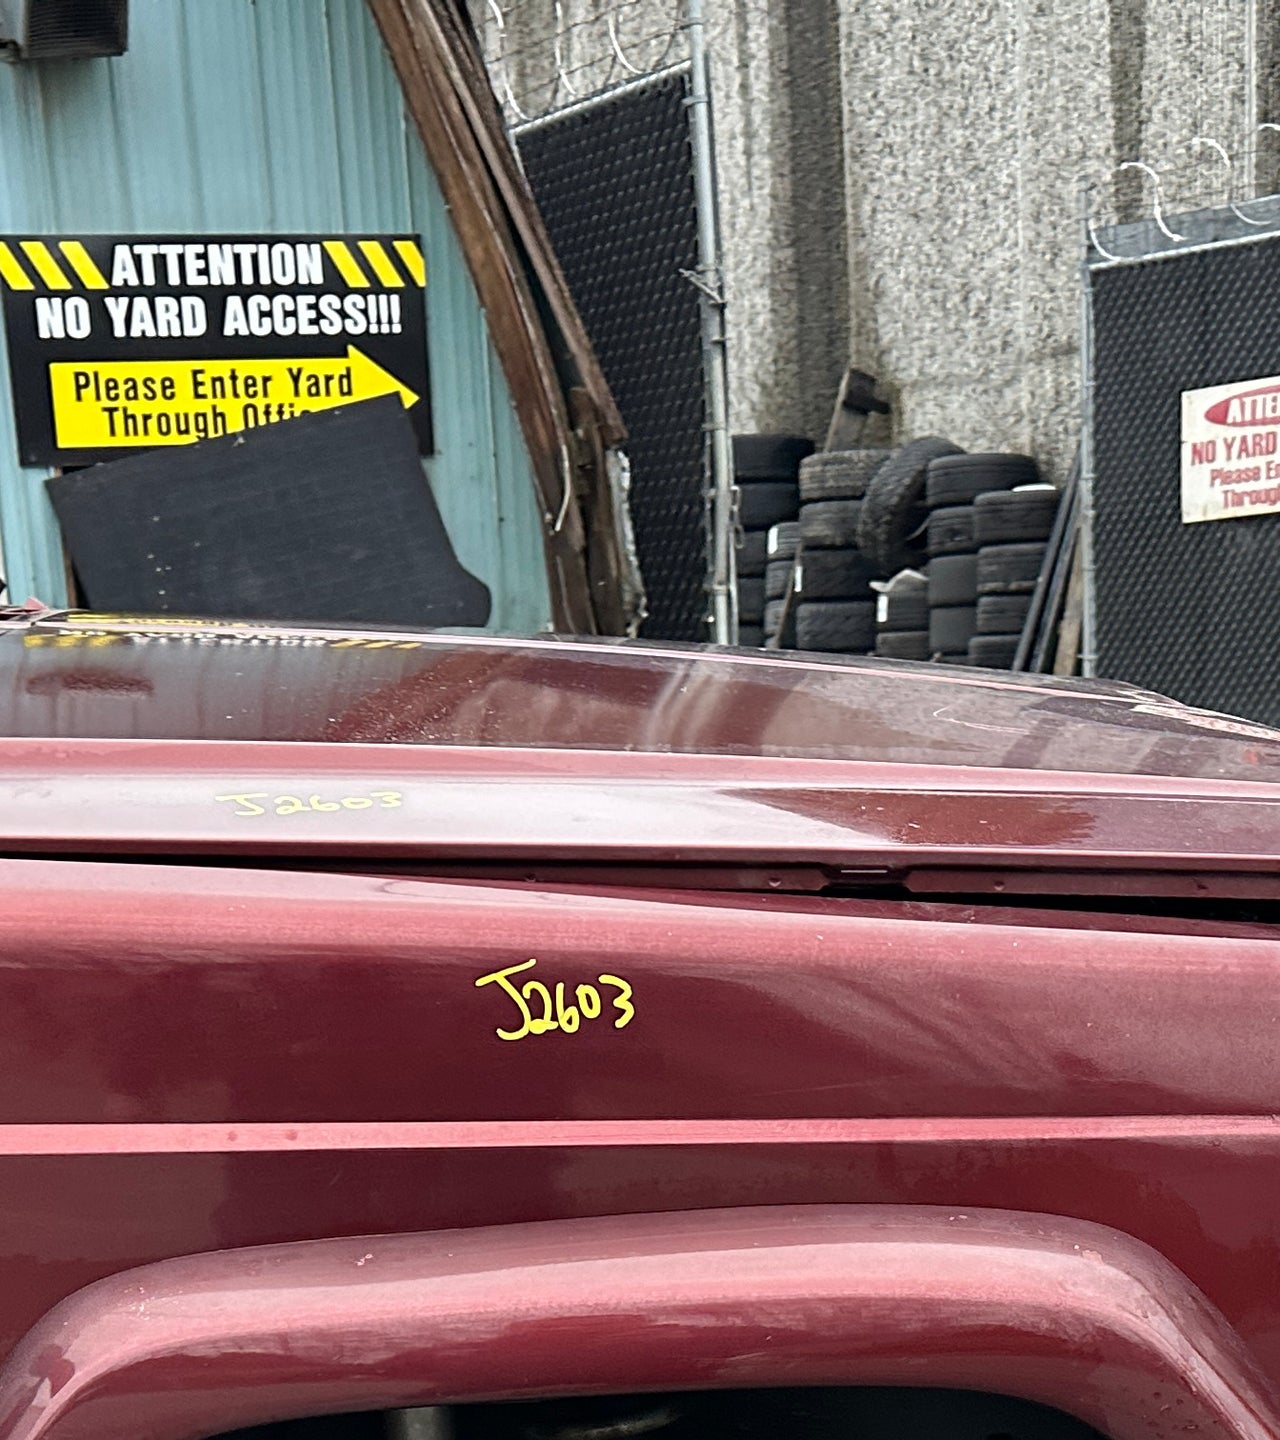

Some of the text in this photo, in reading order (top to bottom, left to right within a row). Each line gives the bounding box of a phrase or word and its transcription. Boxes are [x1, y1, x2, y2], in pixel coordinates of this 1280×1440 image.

[111, 243, 324, 287] ATTENTION
[34, 293, 403, 340] NO YARD ACCESS!!!
[73, 366, 353, 402] Please Enter Yard
[101, 405, 227, 440] Through
[1191, 440, 1217, 466] NO
[1222, 431, 1277, 462] YARD
[1210, 463, 1261, 488] Please
[216, 790, 403, 816] J2603
[475, 958, 635, 1041] J2603
